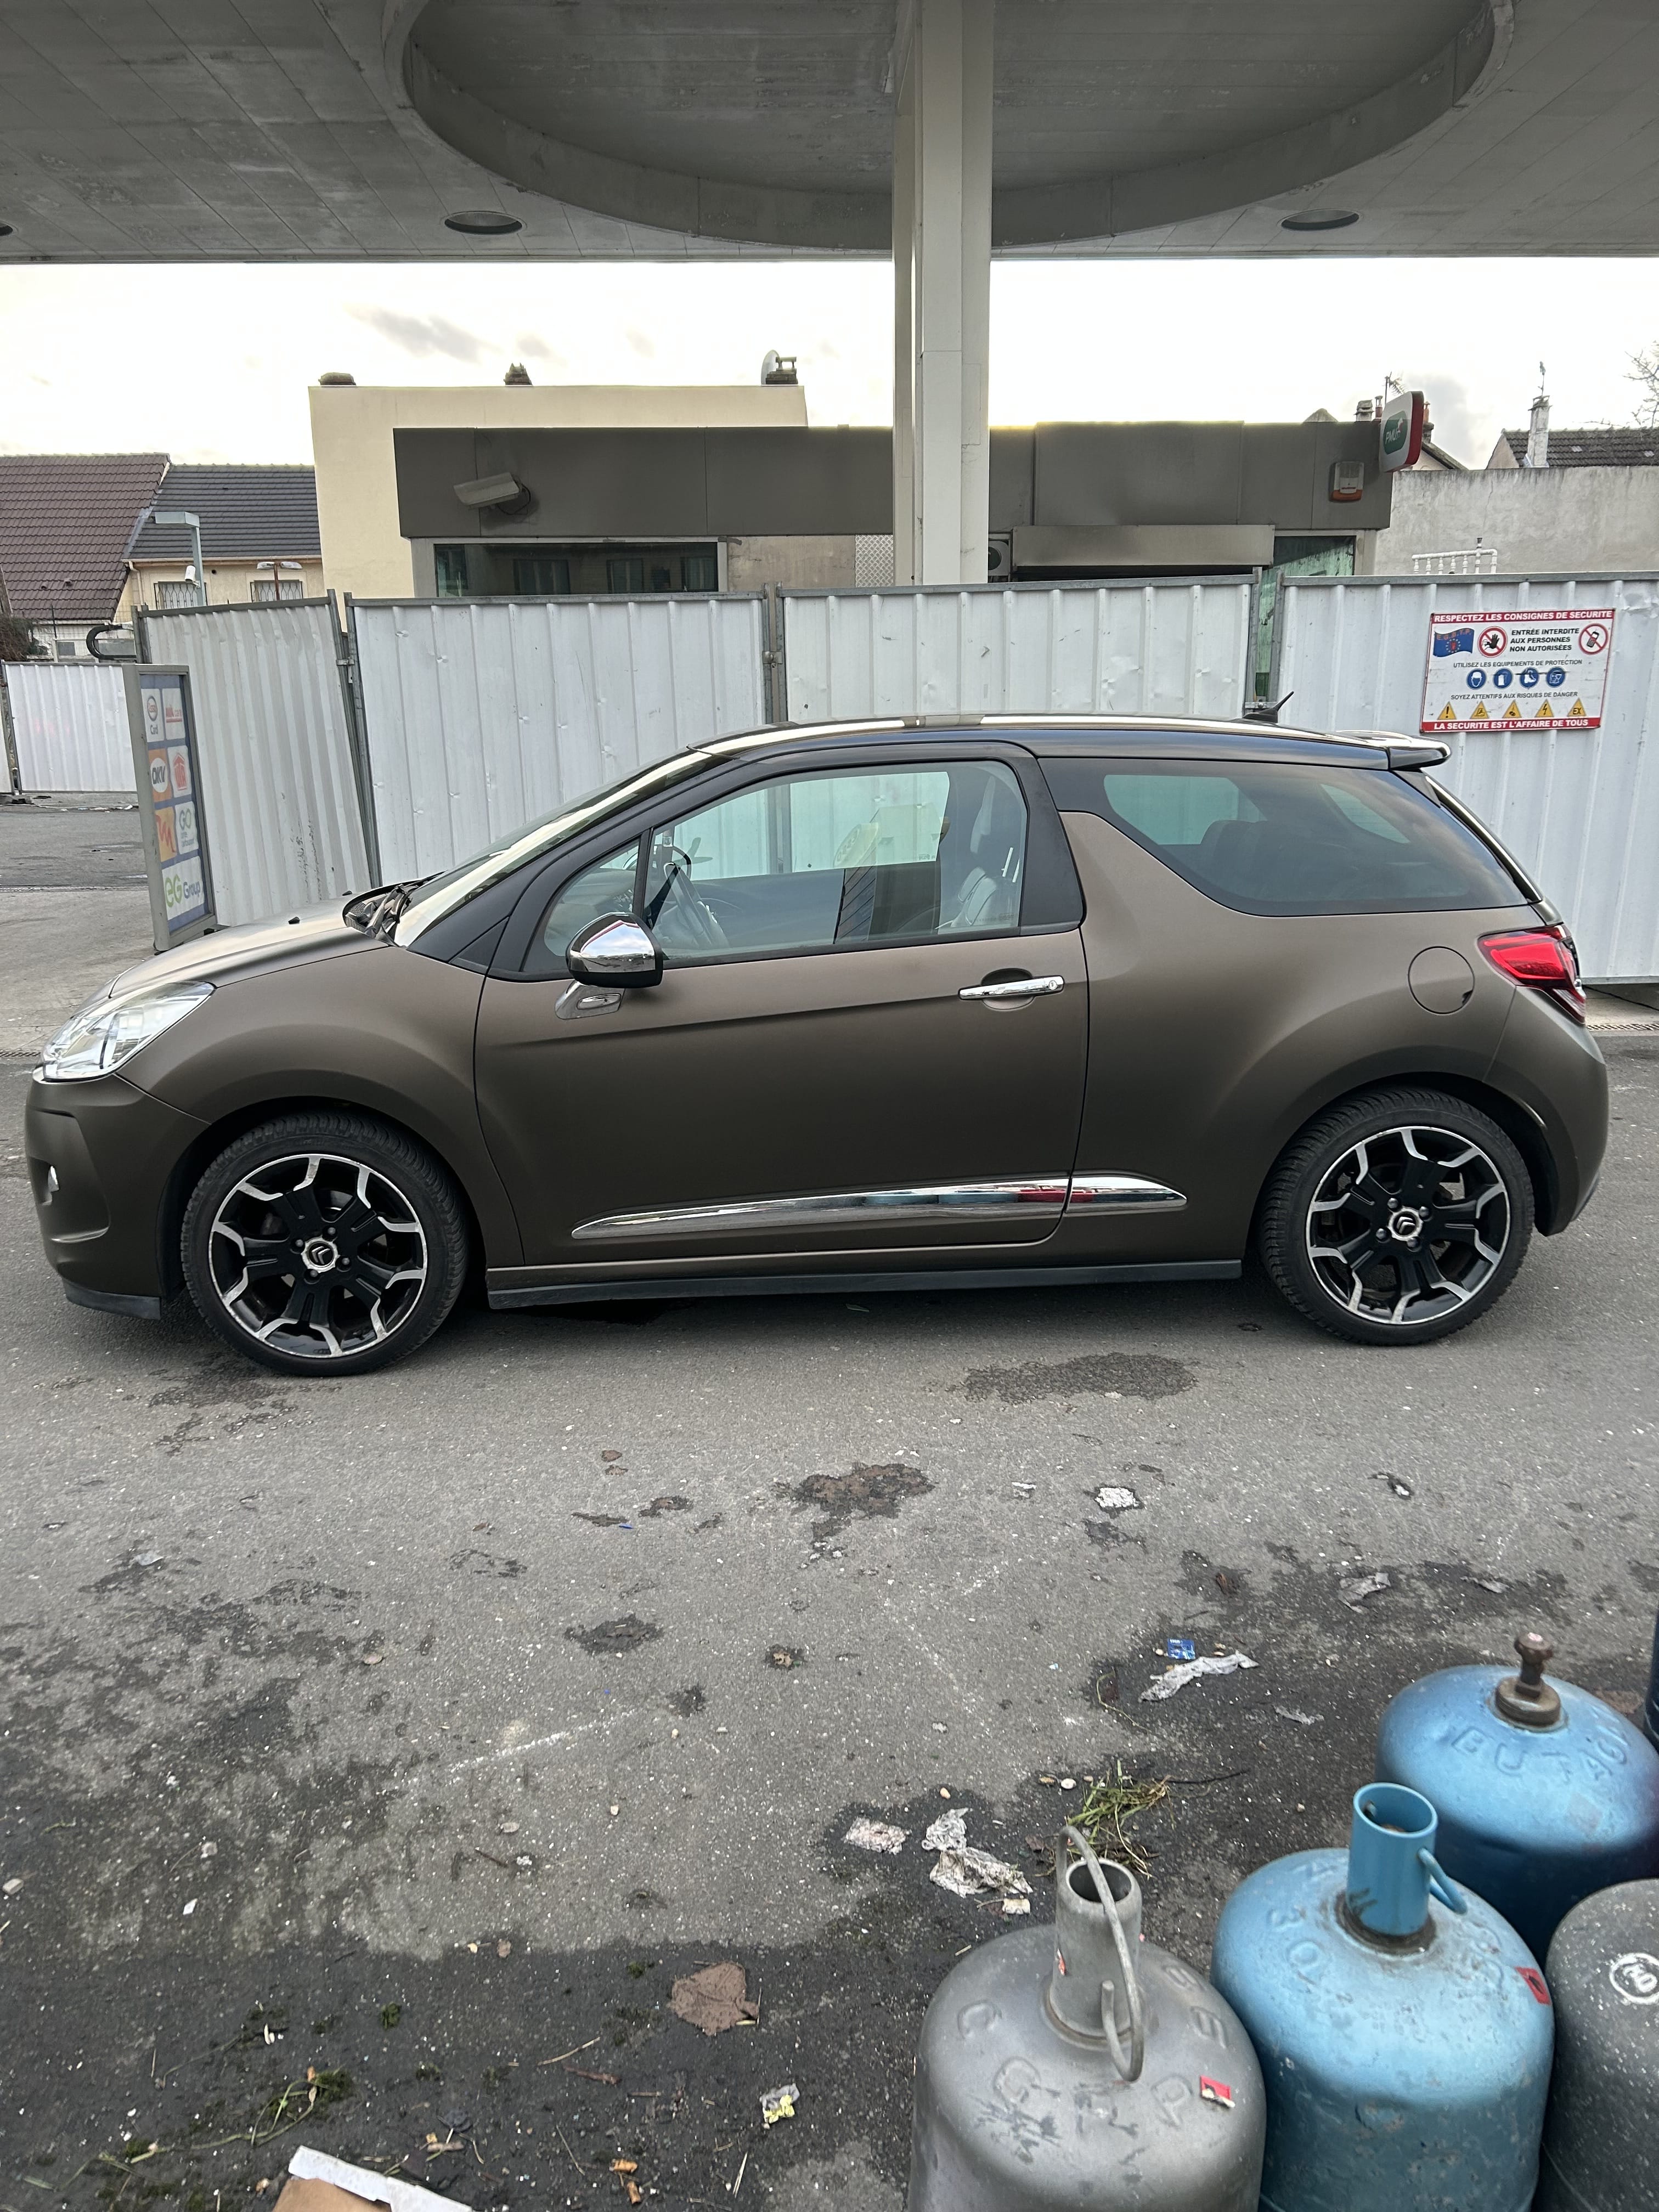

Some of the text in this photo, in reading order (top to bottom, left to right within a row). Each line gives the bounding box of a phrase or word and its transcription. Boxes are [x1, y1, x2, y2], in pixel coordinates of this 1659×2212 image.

[1434, 614, 1484, 622] RESPECTEZ
[1569, 611, 1612, 619] SECURITE
[151, 766, 166, 785] DKV
[183, 881, 201, 899] Group
